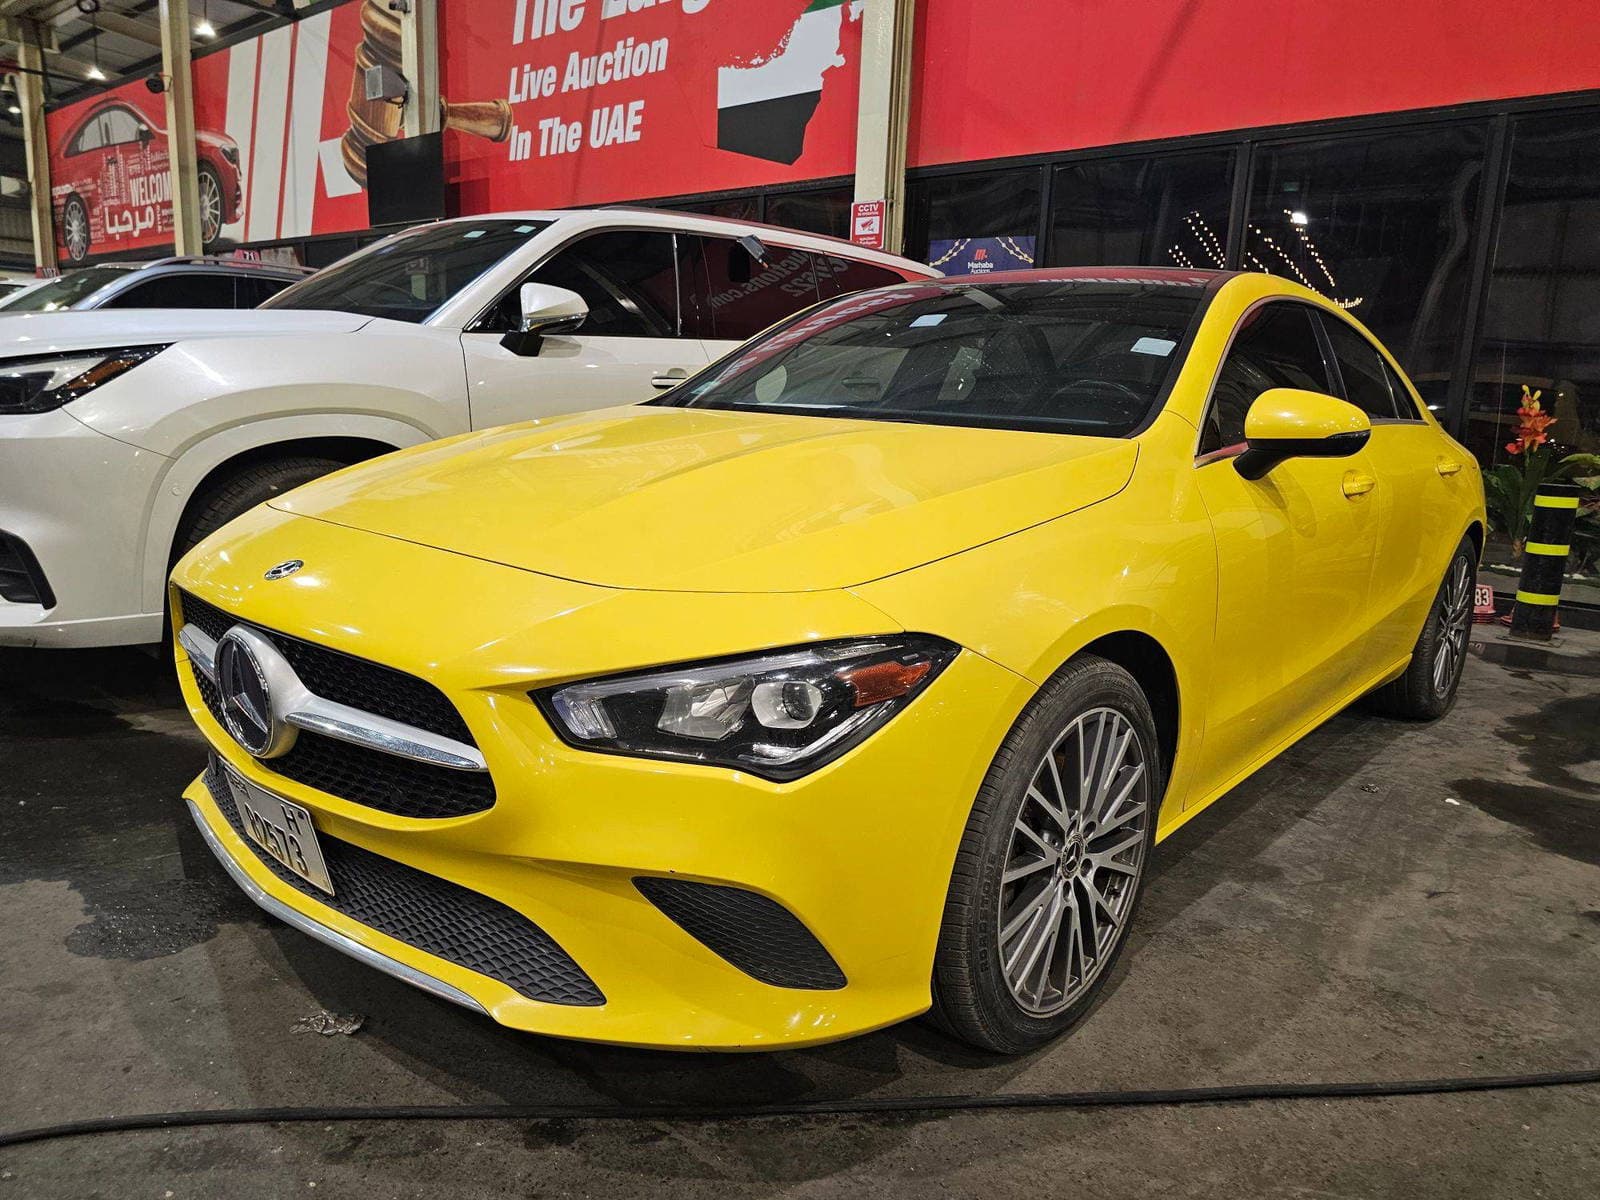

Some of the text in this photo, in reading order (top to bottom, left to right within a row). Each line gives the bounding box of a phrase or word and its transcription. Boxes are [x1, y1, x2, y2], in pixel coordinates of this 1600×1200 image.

[508, 37, 669, 104] Live Auction
[509, 100, 645, 162] In The UAE
[104, 205, 155, 240] مرحبا
[858, 203, 879, 212] CCTV
[967, 261, 994, 269] Marhaba
[1474, 588, 1490, 606] 83
[280, 803, 302, 836] H
